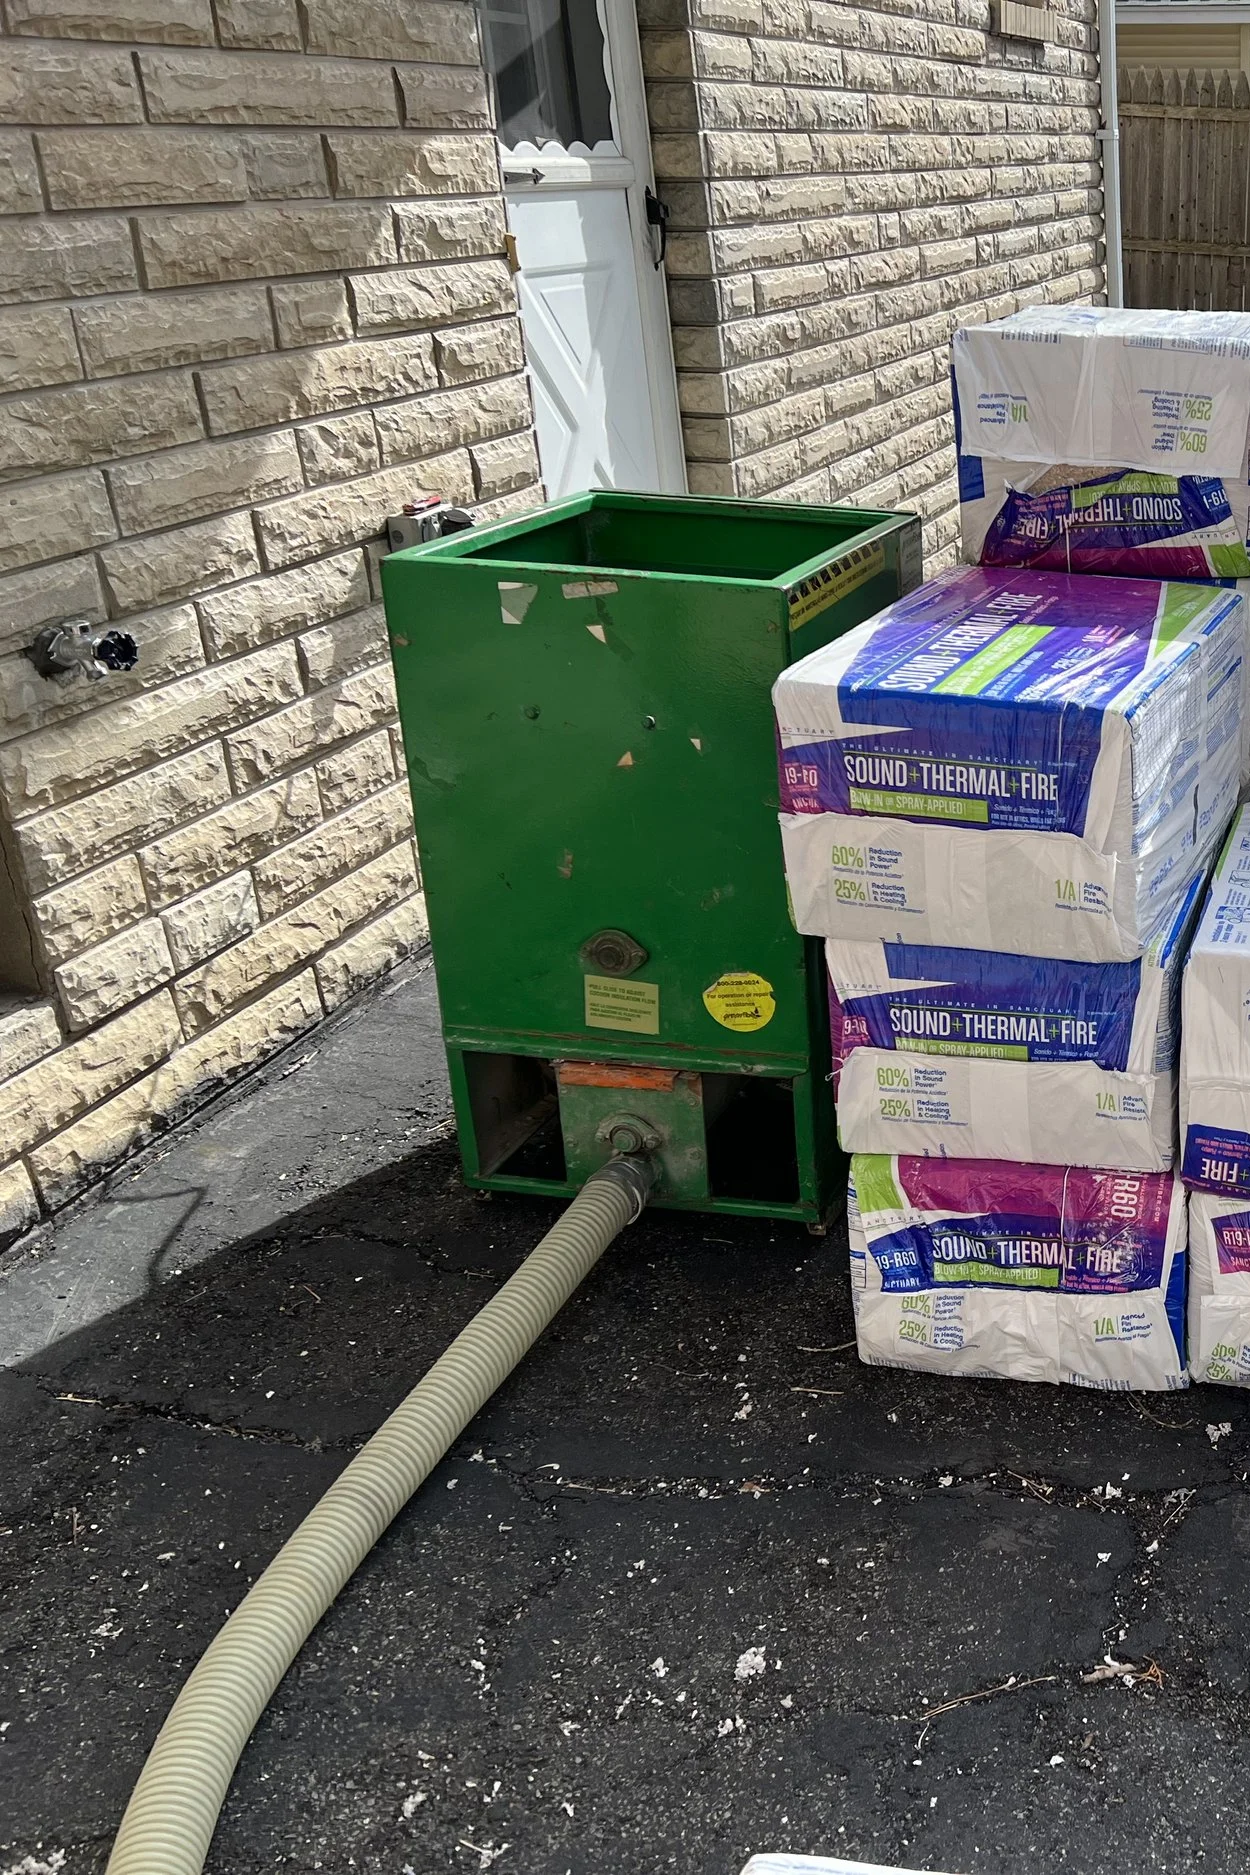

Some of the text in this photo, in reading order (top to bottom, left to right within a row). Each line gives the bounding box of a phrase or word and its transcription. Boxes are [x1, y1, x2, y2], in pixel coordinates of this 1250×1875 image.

[832, 845, 864, 868] 60%
[834, 878, 866, 901] 25%
[877, 1067, 909, 1087] 60%
[879, 1098, 911, 1118] 25%
[899, 1319, 927, 1342] 25%
